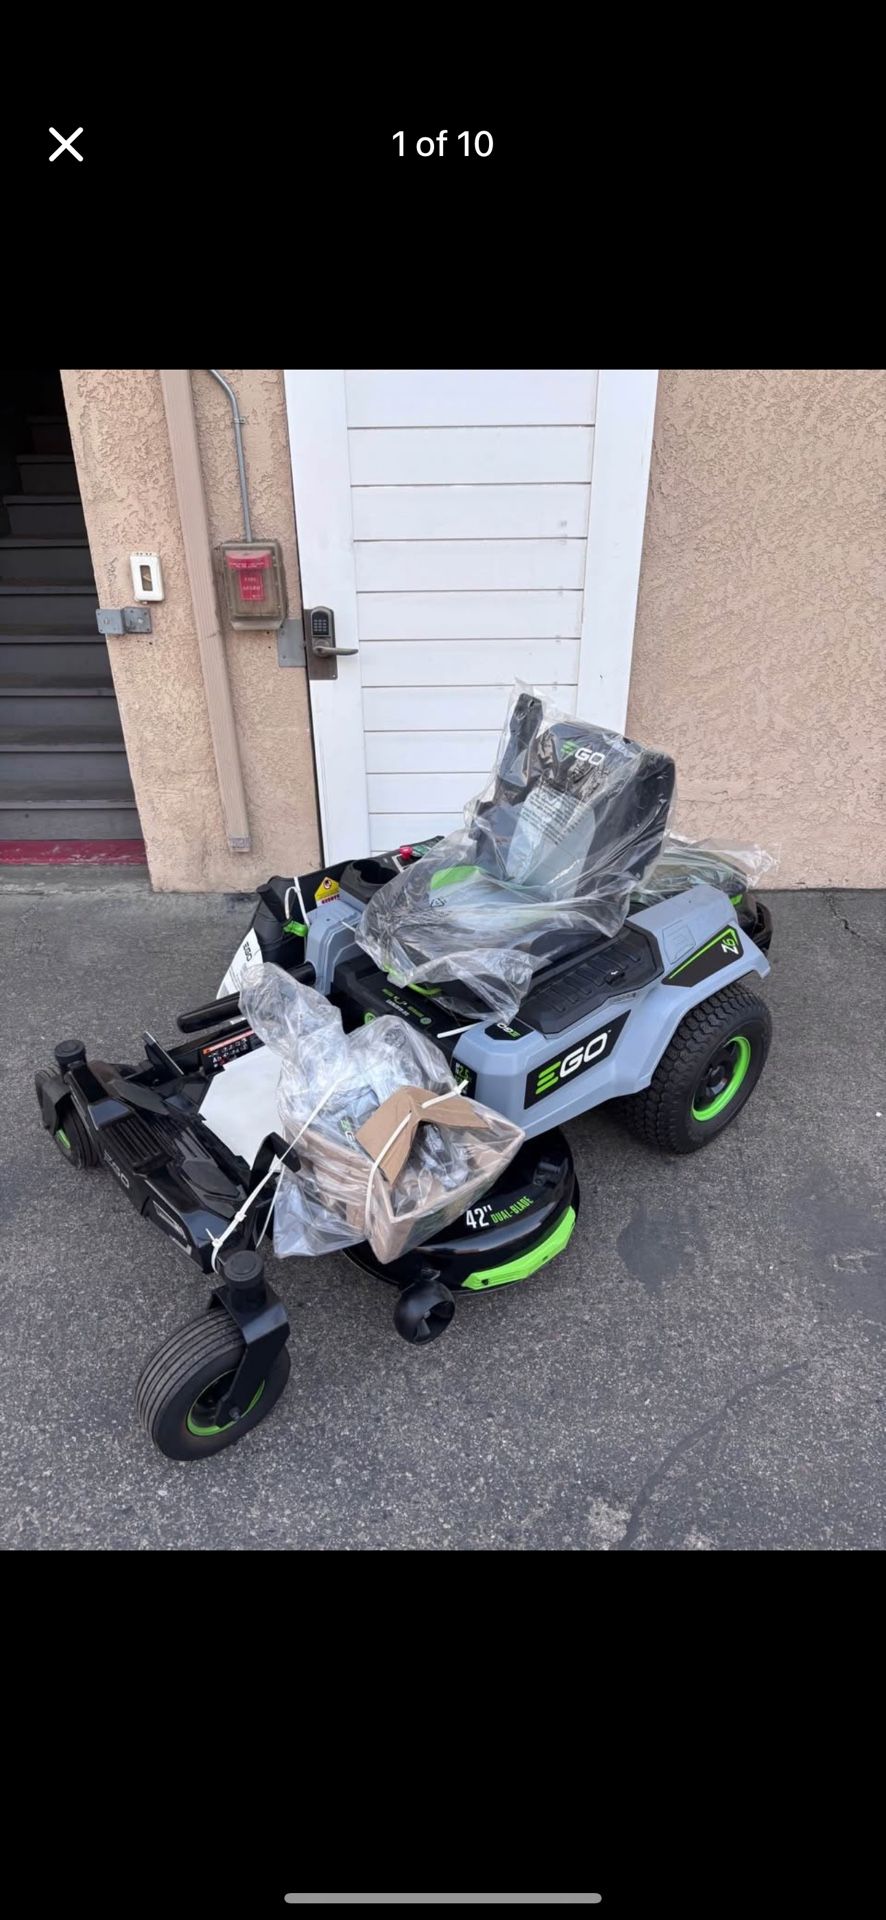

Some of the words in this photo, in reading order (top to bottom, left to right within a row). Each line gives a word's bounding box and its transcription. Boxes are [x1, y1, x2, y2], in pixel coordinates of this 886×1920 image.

[561, 740, 606, 767] EGO
[720, 938, 740, 955] Z6
[535, 1032, 608, 1095] EGO
[465, 1204, 493, 1229] 42"
[490, 1195, 535, 1224] DUAL-BLADE
